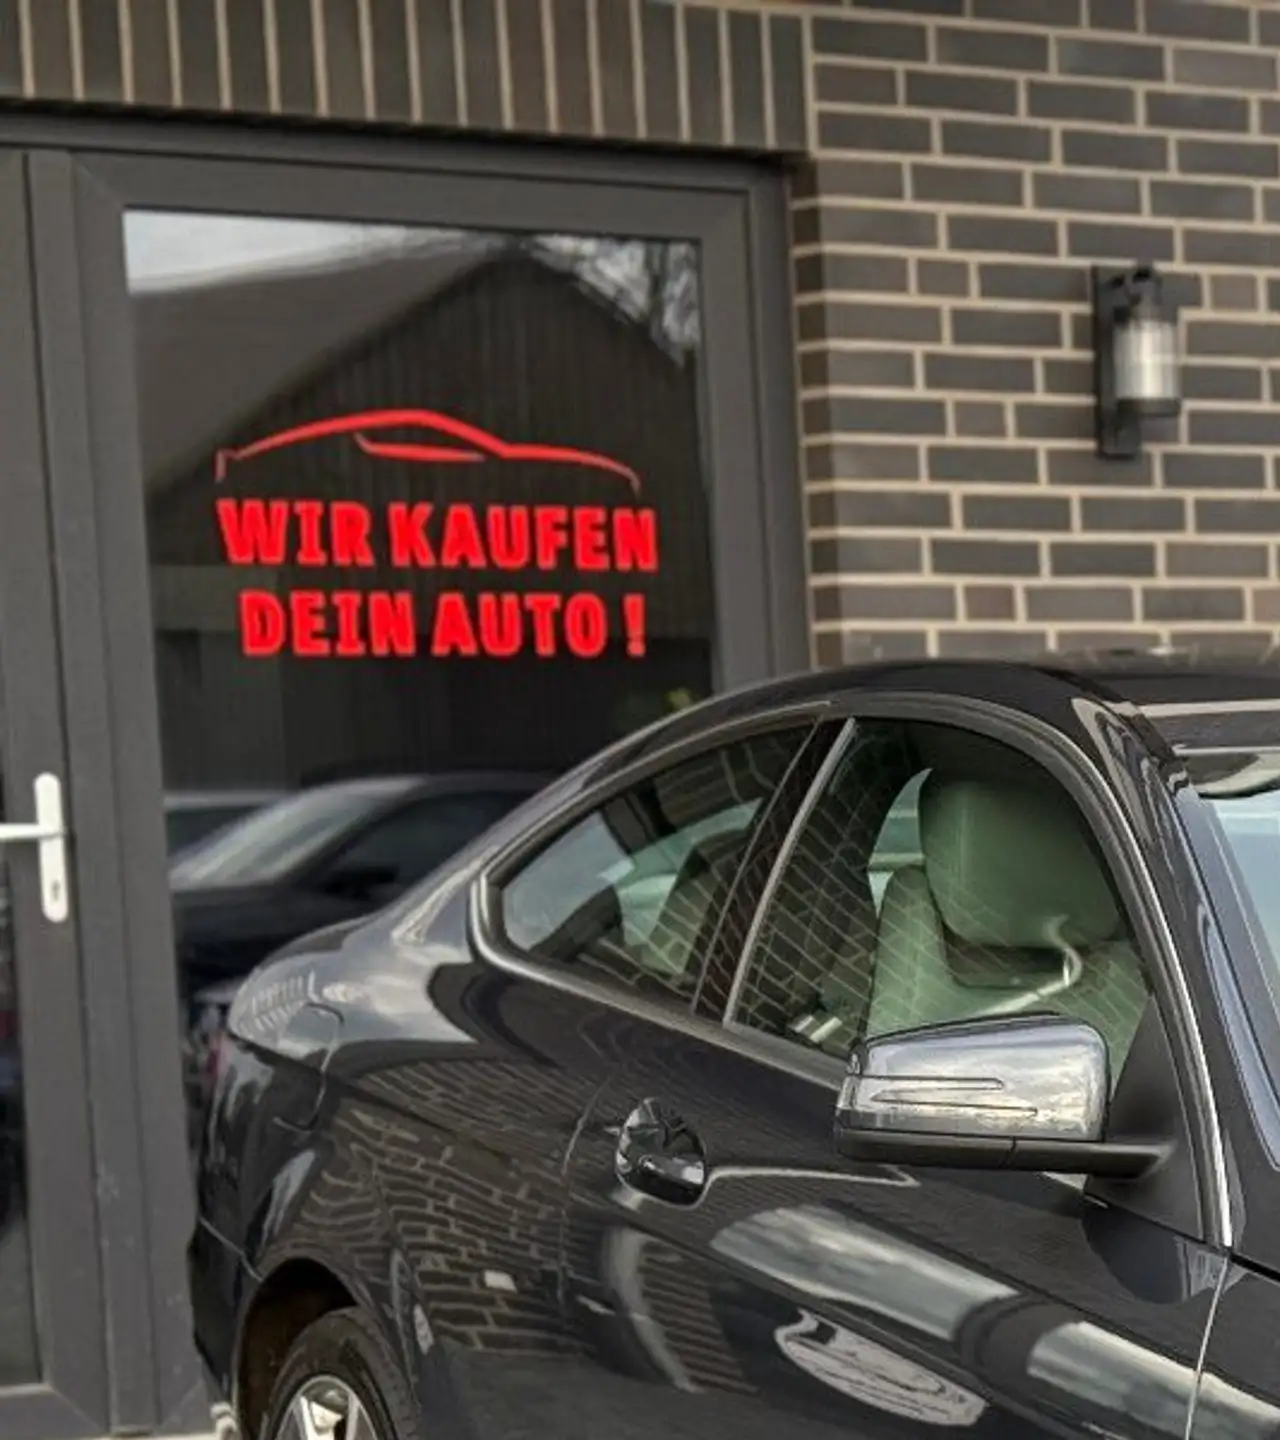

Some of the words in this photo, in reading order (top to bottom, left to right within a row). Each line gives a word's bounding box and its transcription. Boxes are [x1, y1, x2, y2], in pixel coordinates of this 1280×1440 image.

[216, 497, 375, 568] WIR
[386, 502, 659, 573] KAUFEN
[238, 588, 417, 657] DEIN
[430, 591, 608, 658] AUTO
[622, 594, 646, 656] !
